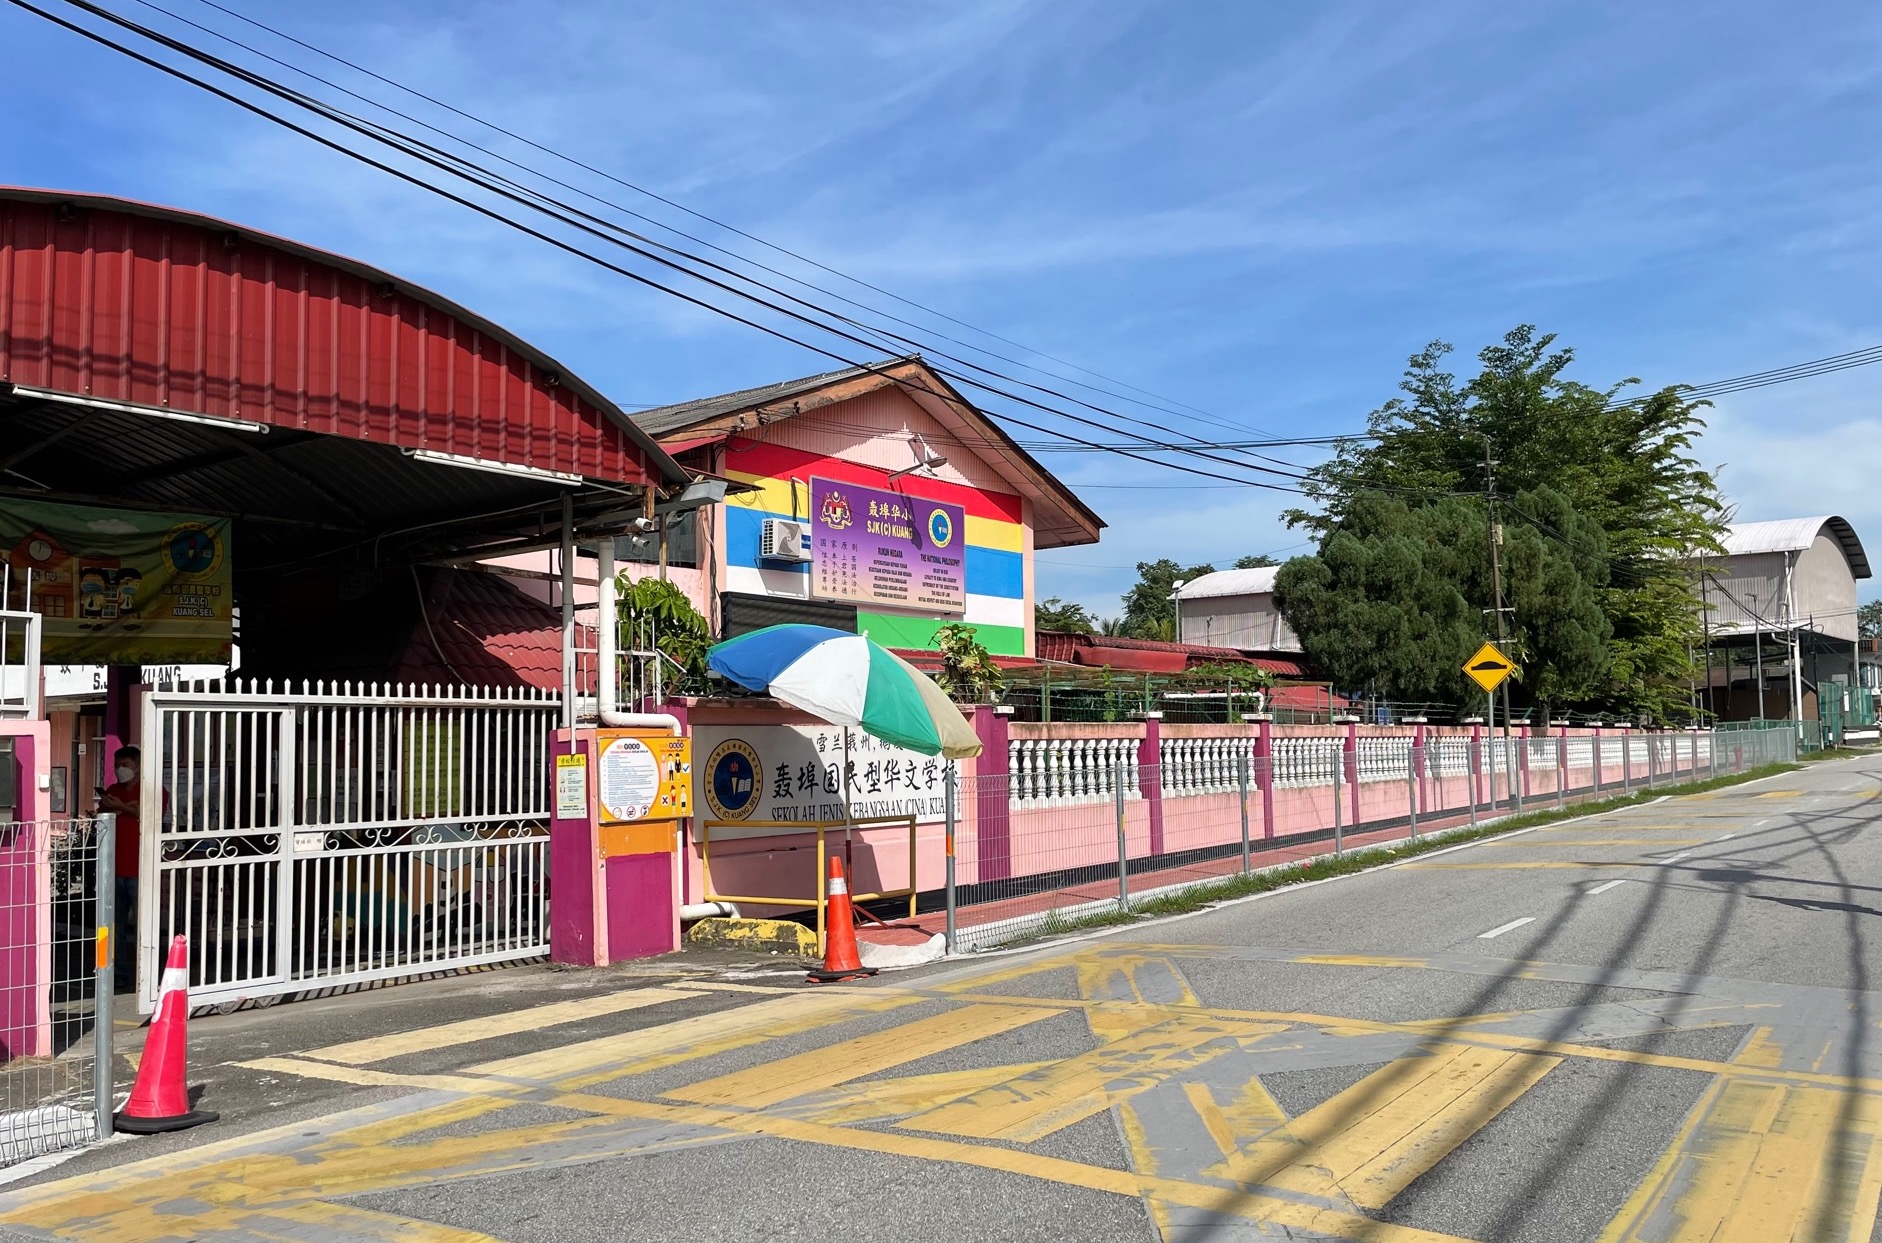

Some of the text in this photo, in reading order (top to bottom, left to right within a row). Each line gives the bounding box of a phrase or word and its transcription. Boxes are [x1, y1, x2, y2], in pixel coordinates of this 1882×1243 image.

[868, 500, 912, 522] 轰埠华小
[892, 524, 913, 540] KUANG
[172, 607, 214, 617] KUANG SEL
[731, 807, 750, 819] KUANG
[749, 796, 758, 808] SEL
[772, 804, 815, 821] SEKOLAH
[905, 798, 927, 818] (CINA)
[929, 797, 947, 814] KUA
